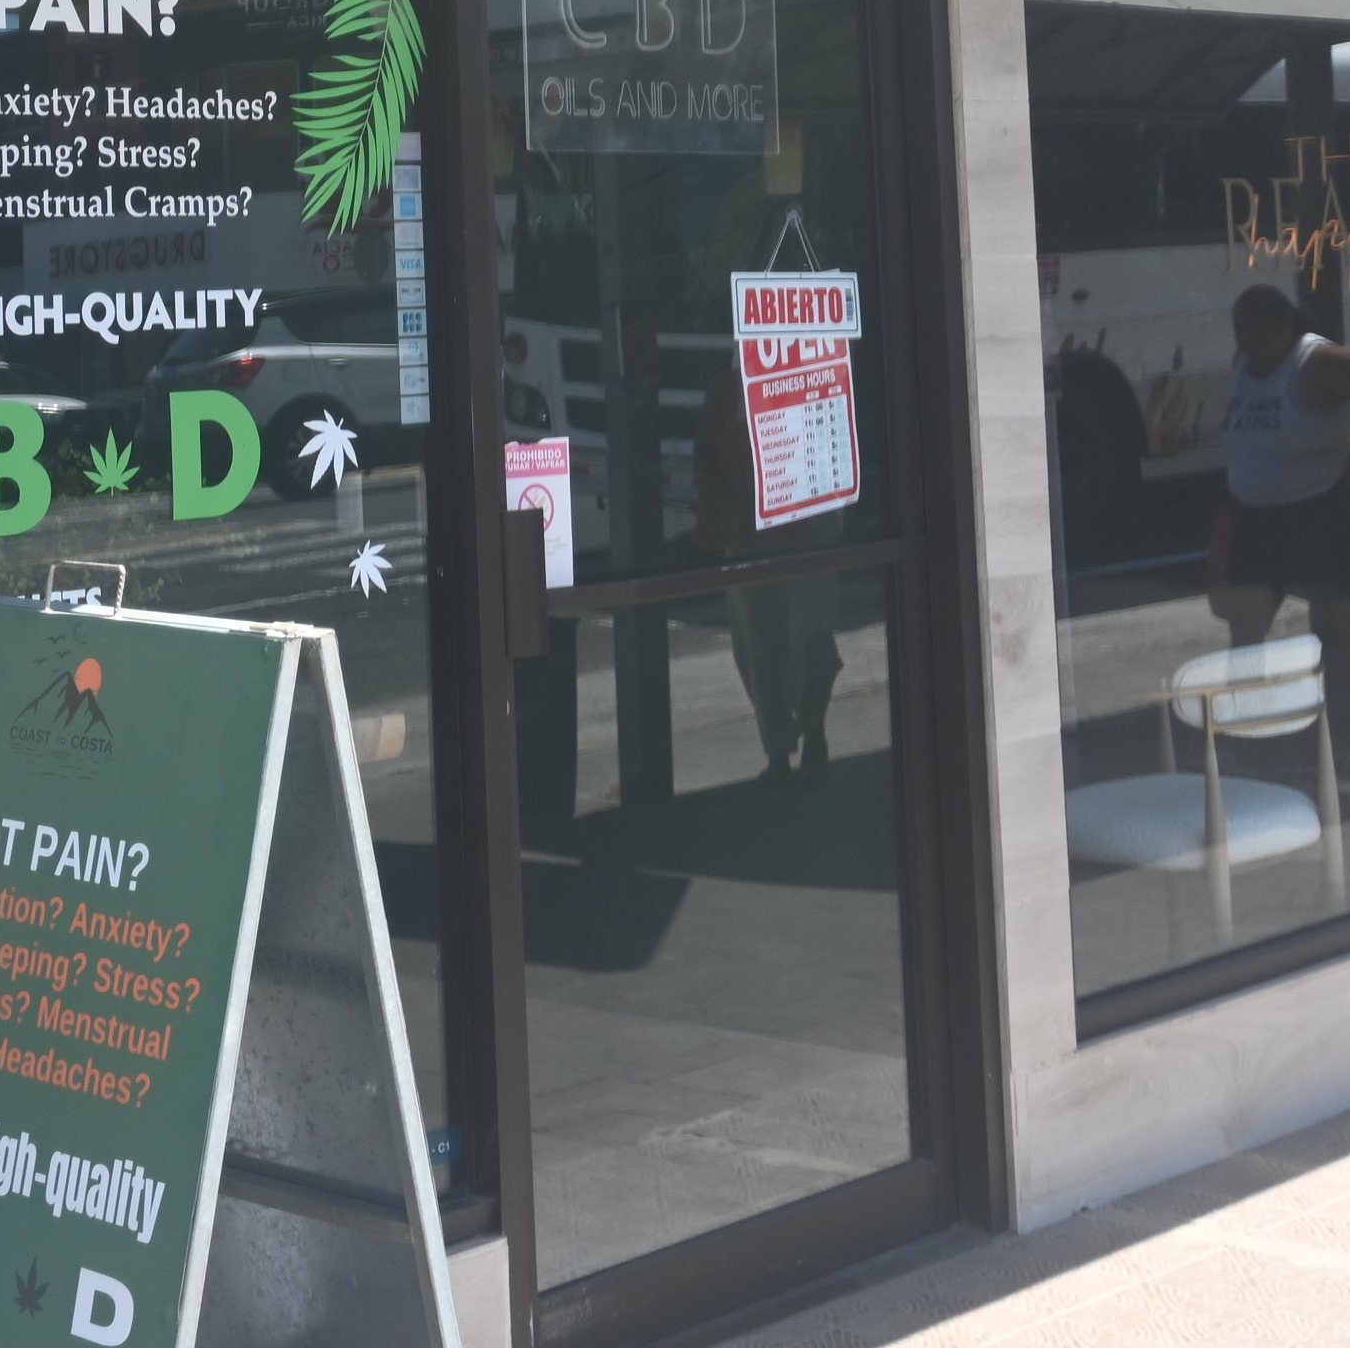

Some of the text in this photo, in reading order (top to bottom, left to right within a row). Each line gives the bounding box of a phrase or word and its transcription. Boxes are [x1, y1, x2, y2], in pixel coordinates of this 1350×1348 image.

[104, 86, 278, 121] Headaches?
[541, 76, 764, 121] OILS AND MORE
[98, 136, 201, 169] Stress?
[124, 186, 253, 227] Cramps?
[400, 258, 422, 270] VISA
[744, 286, 843, 325] ABIERTO
[762, 375, 805, 398] BUSINESS
[806, 368, 836, 390] HOURS
[757, 410, 786, 425] MONDAY
[760, 425, 788, 439] TUESDAY
[169, 389, 262, 521] D
[507, 448, 562, 463] PROHIBIDO
[762, 435, 800, 452] WEDNESDAY
[536, 459, 565, 470] VAPEAR
[10, 726, 52, 743] COAST
[71, 735, 113, 754] COSTA
[30, 824, 150, 891] PAIN?
[69, 902, 191, 962] Anxiety?
[94, 958, 201, 1013] Stress?
[37, 996, 172, 1061] Menstrual
[70, 1267, 134, 1347] D
